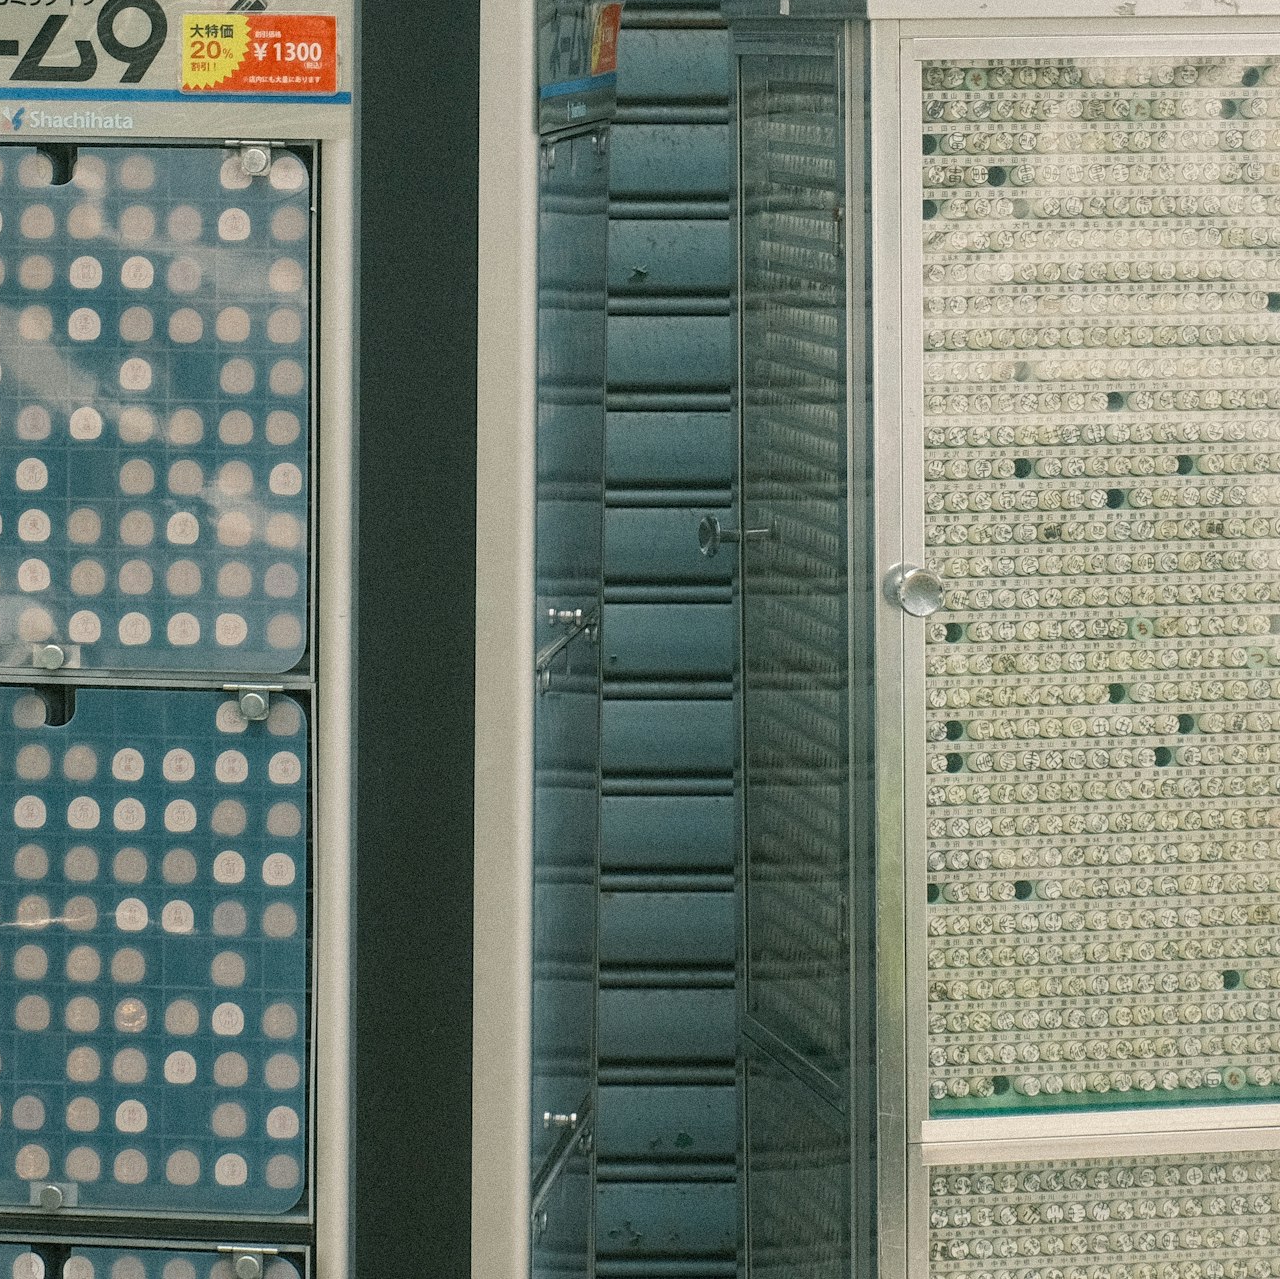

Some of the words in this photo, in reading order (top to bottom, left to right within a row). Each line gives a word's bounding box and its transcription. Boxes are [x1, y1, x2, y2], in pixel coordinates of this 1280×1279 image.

[190, 24, 234, 38] 大特価
[190, 40, 233, 59] 20%
[29, 110, 133, 130] Shachihata
